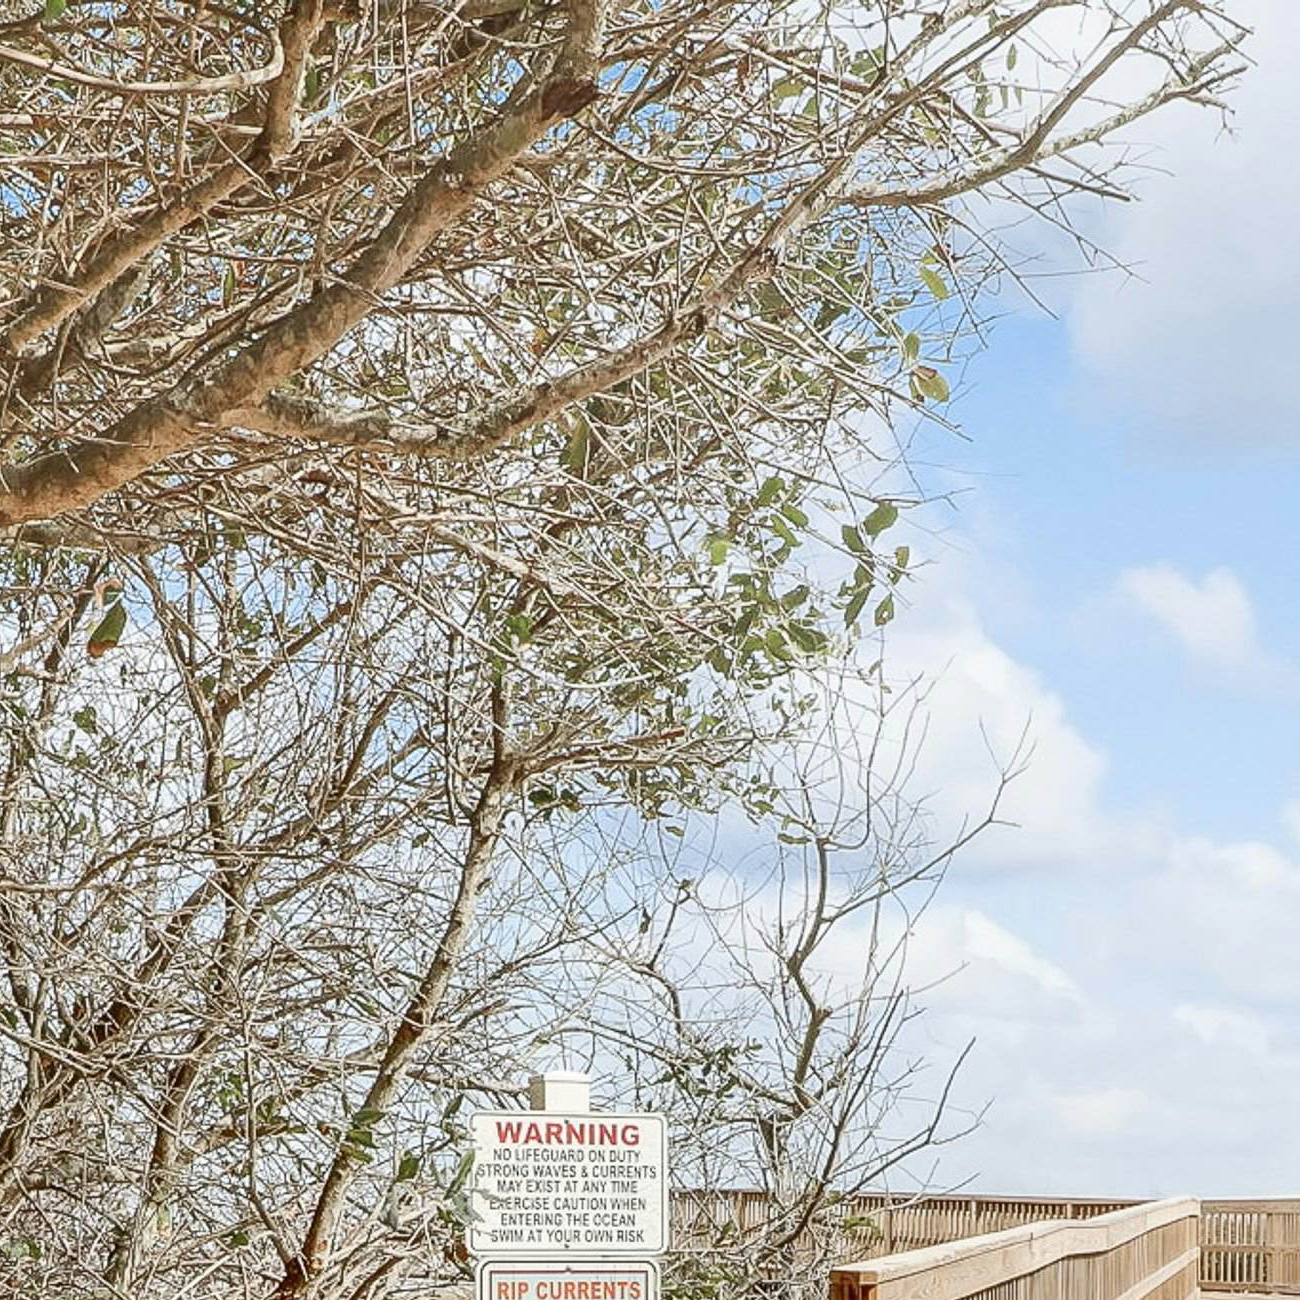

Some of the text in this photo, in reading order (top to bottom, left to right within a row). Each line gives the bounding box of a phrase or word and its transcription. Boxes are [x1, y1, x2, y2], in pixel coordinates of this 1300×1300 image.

[496, 1121, 640, 1146] WARNING
[493, 1148, 641, 1163] NO LIFEGUARD ON DUTY
[477, 1164, 656, 1179] STRONG WAVES & CURRENTS
[497, 1180, 638, 1194] MAY EXIST AT ANY TIME
[489, 1197, 646, 1211] EXERCISE CAUTION WHEN
[500, 1213, 636, 1227] ENTERING THE OCEAN
[490, 1229, 644, 1243] SWIM AT YOUR OWN RISK
[497, 1281, 641, 1300] RIP CURRENTS
